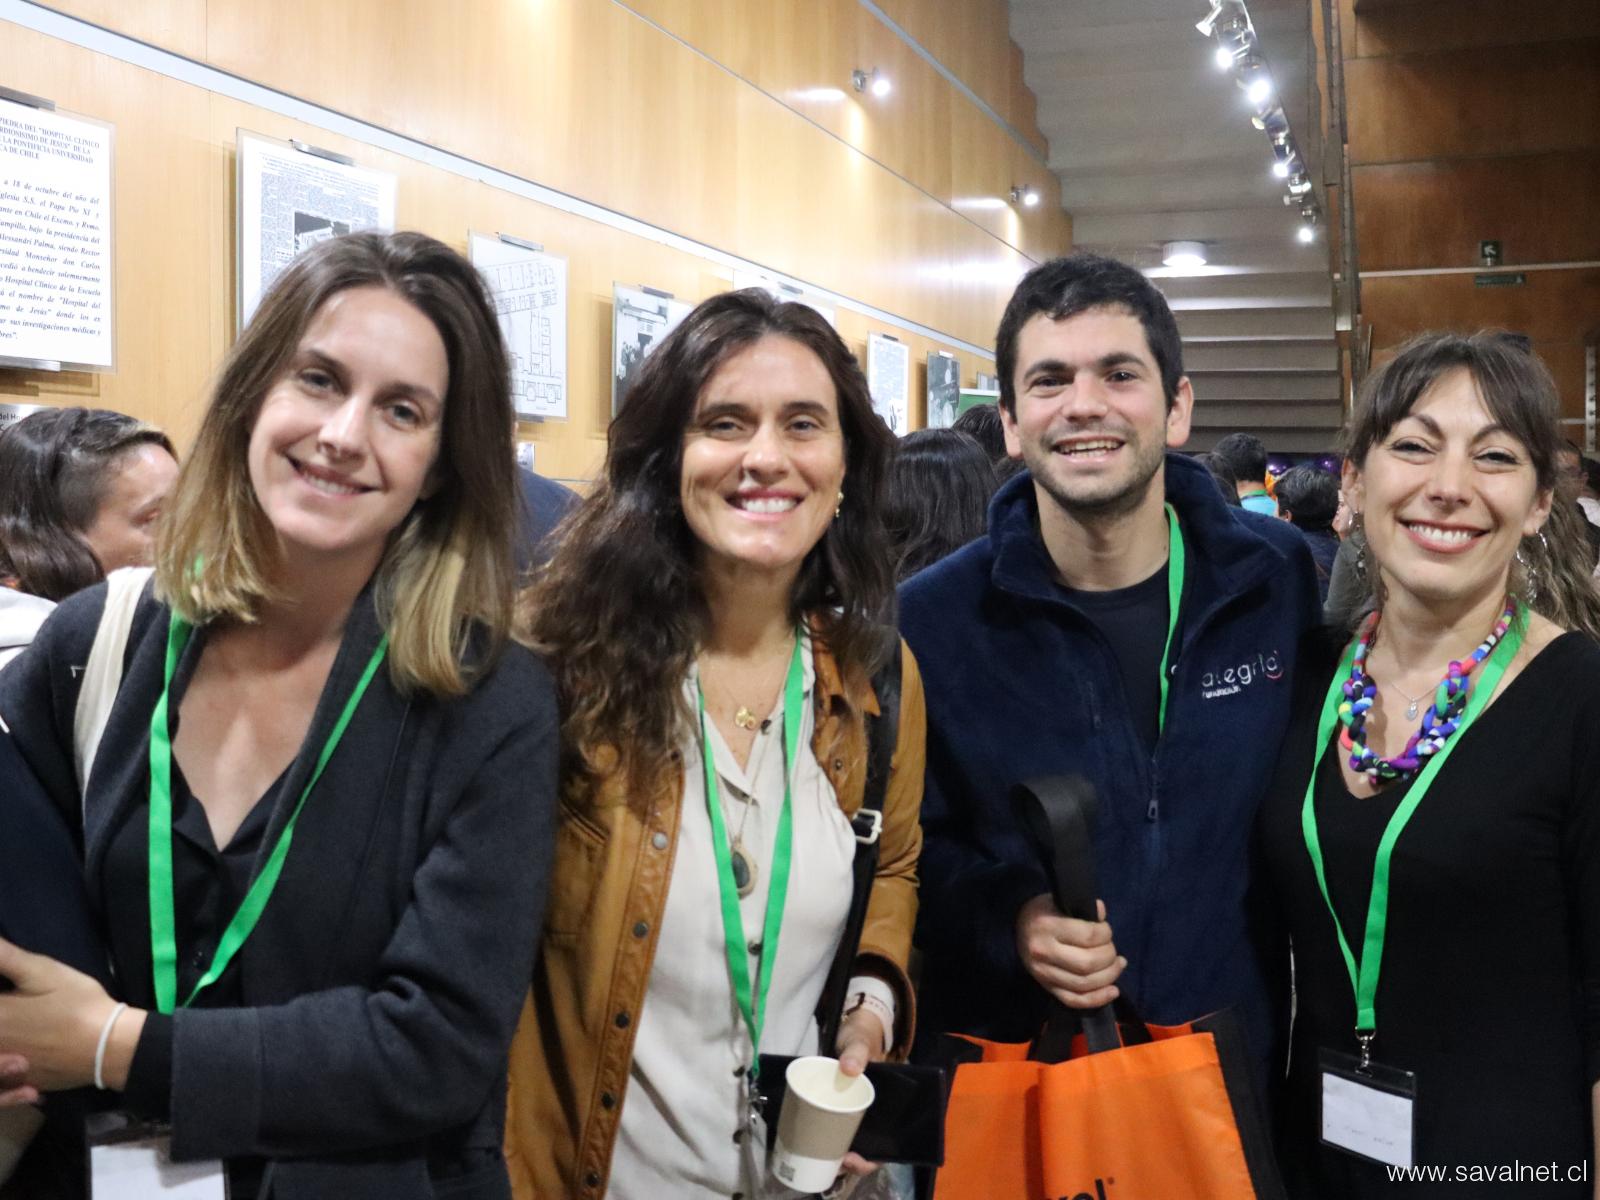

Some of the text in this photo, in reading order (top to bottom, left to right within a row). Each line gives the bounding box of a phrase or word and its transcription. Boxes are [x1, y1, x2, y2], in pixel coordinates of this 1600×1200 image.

[9, 146, 19, 154] DE
[20, 149, 40, 160] CHILE
[13, 179, 21, 188] 18
[35, 185, 60, 196] octubre
[0, 191, 20, 202] glesia
[50, 201, 65, 211] Papa
[25, 209, 42, 220] Chile
[0, 220, 100, 244] ampillo, bajo la presidencia del
[58, 244, 79, 253] siendo
[25, 251, 57, 263] Monseñor
[63, 257, 75, 266] don
[28, 265, 55, 276] bendecir
[58, 271, 101, 283] solemnemente
[5, 275, 33, 286] Hospital
[59, 284, 67, 292] de
[77, 286, 101, 296] Escuela
[18, 292, 44, 302] nombre
[47, 295, 55, 303] de
[91, 302, 101, 310] del
[56, 310, 76, 319] donde
[80, 313, 89, 321] los
[22, 319, 70, 331] investigaciones
